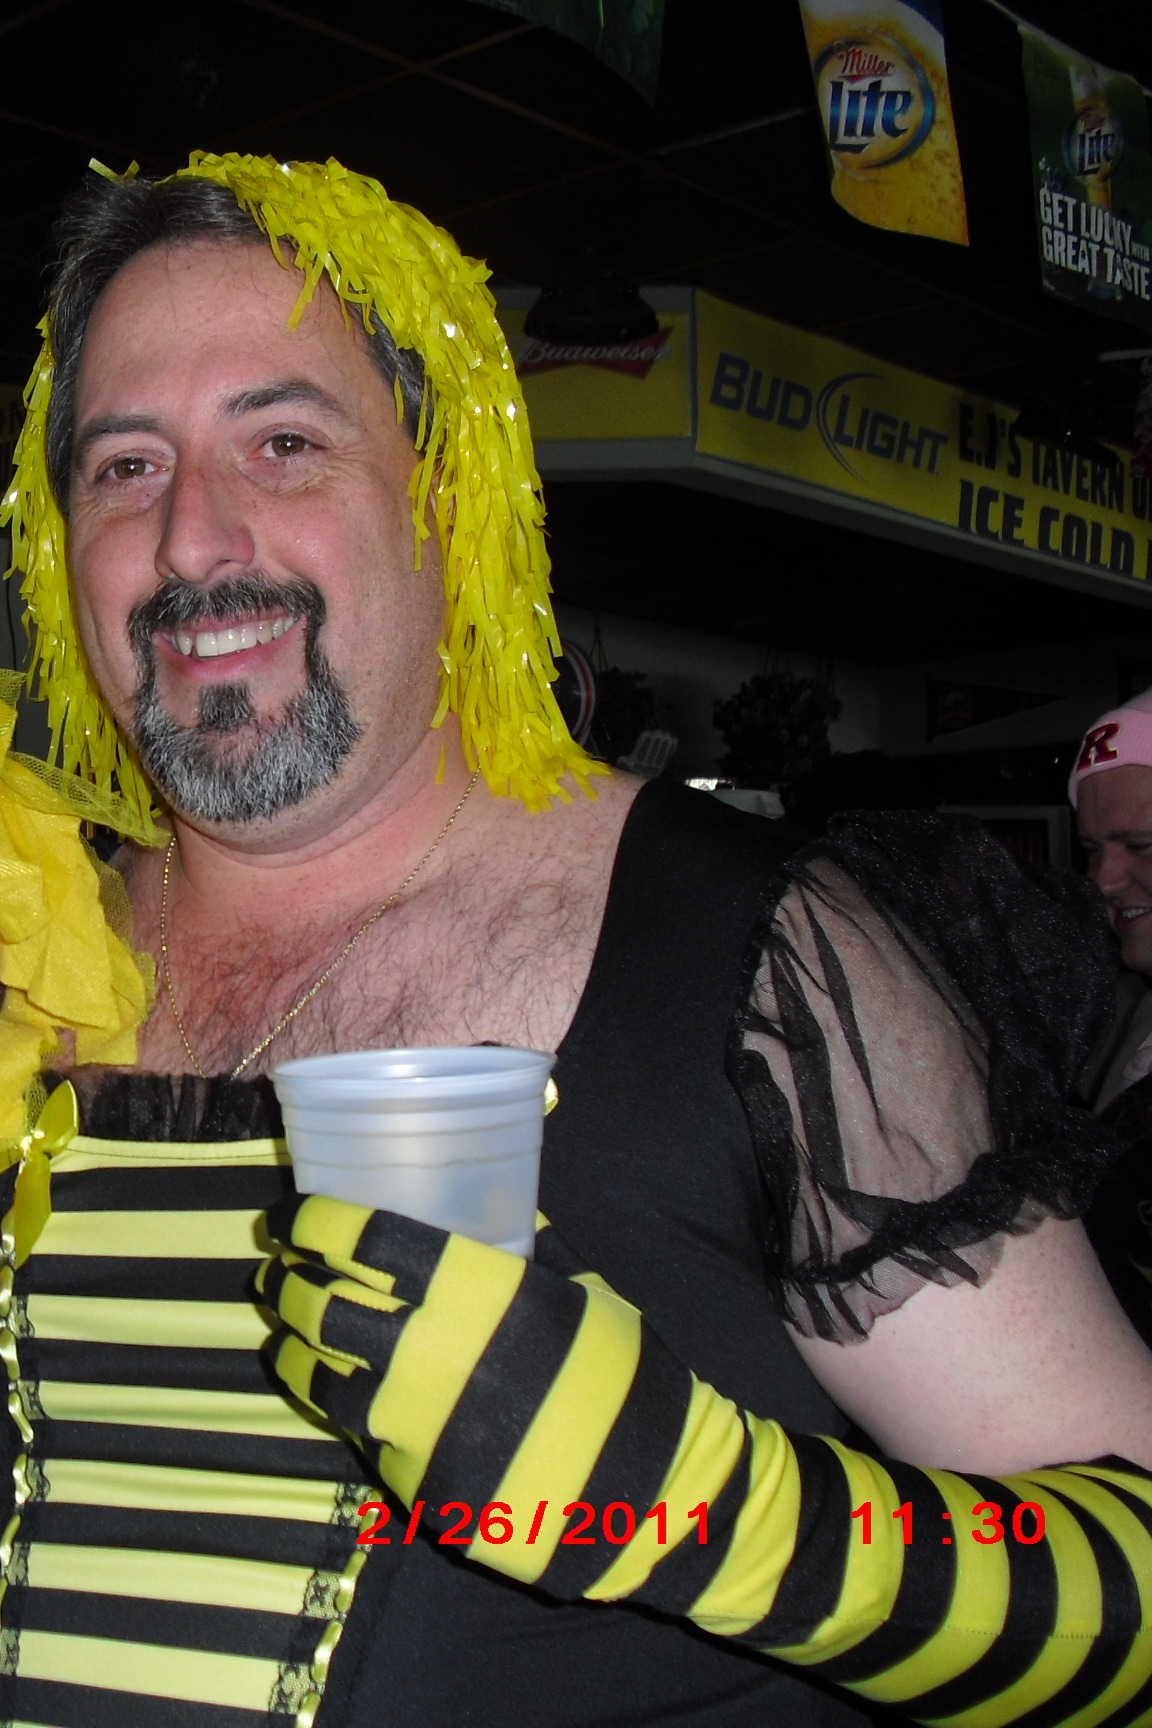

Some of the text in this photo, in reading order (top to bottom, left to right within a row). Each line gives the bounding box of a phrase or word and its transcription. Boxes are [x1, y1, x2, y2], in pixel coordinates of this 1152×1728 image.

[839, 46, 894, 76] Miller
[829, 80, 912, 154] Lite
[1076, 129, 1115, 176] Lite
[1039, 187, 1077, 232] GET
[1080, 202, 1132, 256] LUCKY
[1042, 226, 1150, 301] GREAT TASTE
[709, 352, 949, 474] BUD LIGHT
[958, 479, 1135, 578] ICE COLD
[1076, 723, 1119, 772] R
